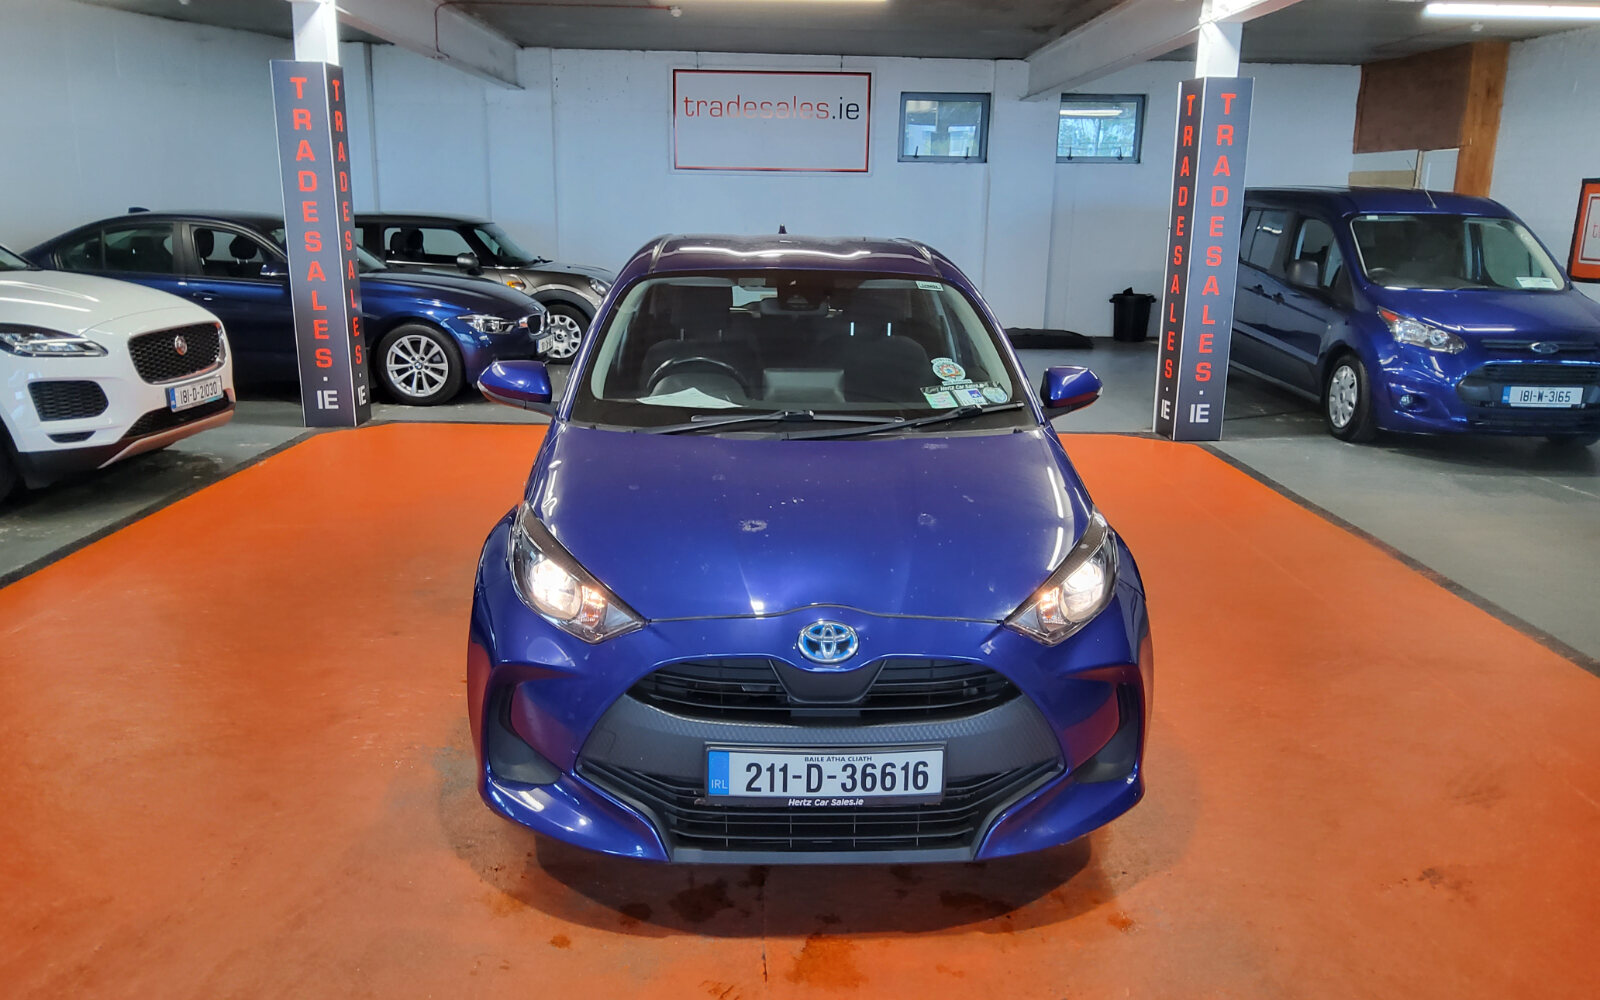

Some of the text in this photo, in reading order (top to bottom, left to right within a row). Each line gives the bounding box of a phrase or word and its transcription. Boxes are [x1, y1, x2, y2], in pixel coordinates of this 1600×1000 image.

[683, 94, 860, 120] tradesales.ie
[711, 778, 728, 790] IRL
[745, 760, 929, 793] 211-D-36616
[788, 798, 864, 806] Hertz Car Sales.ie
